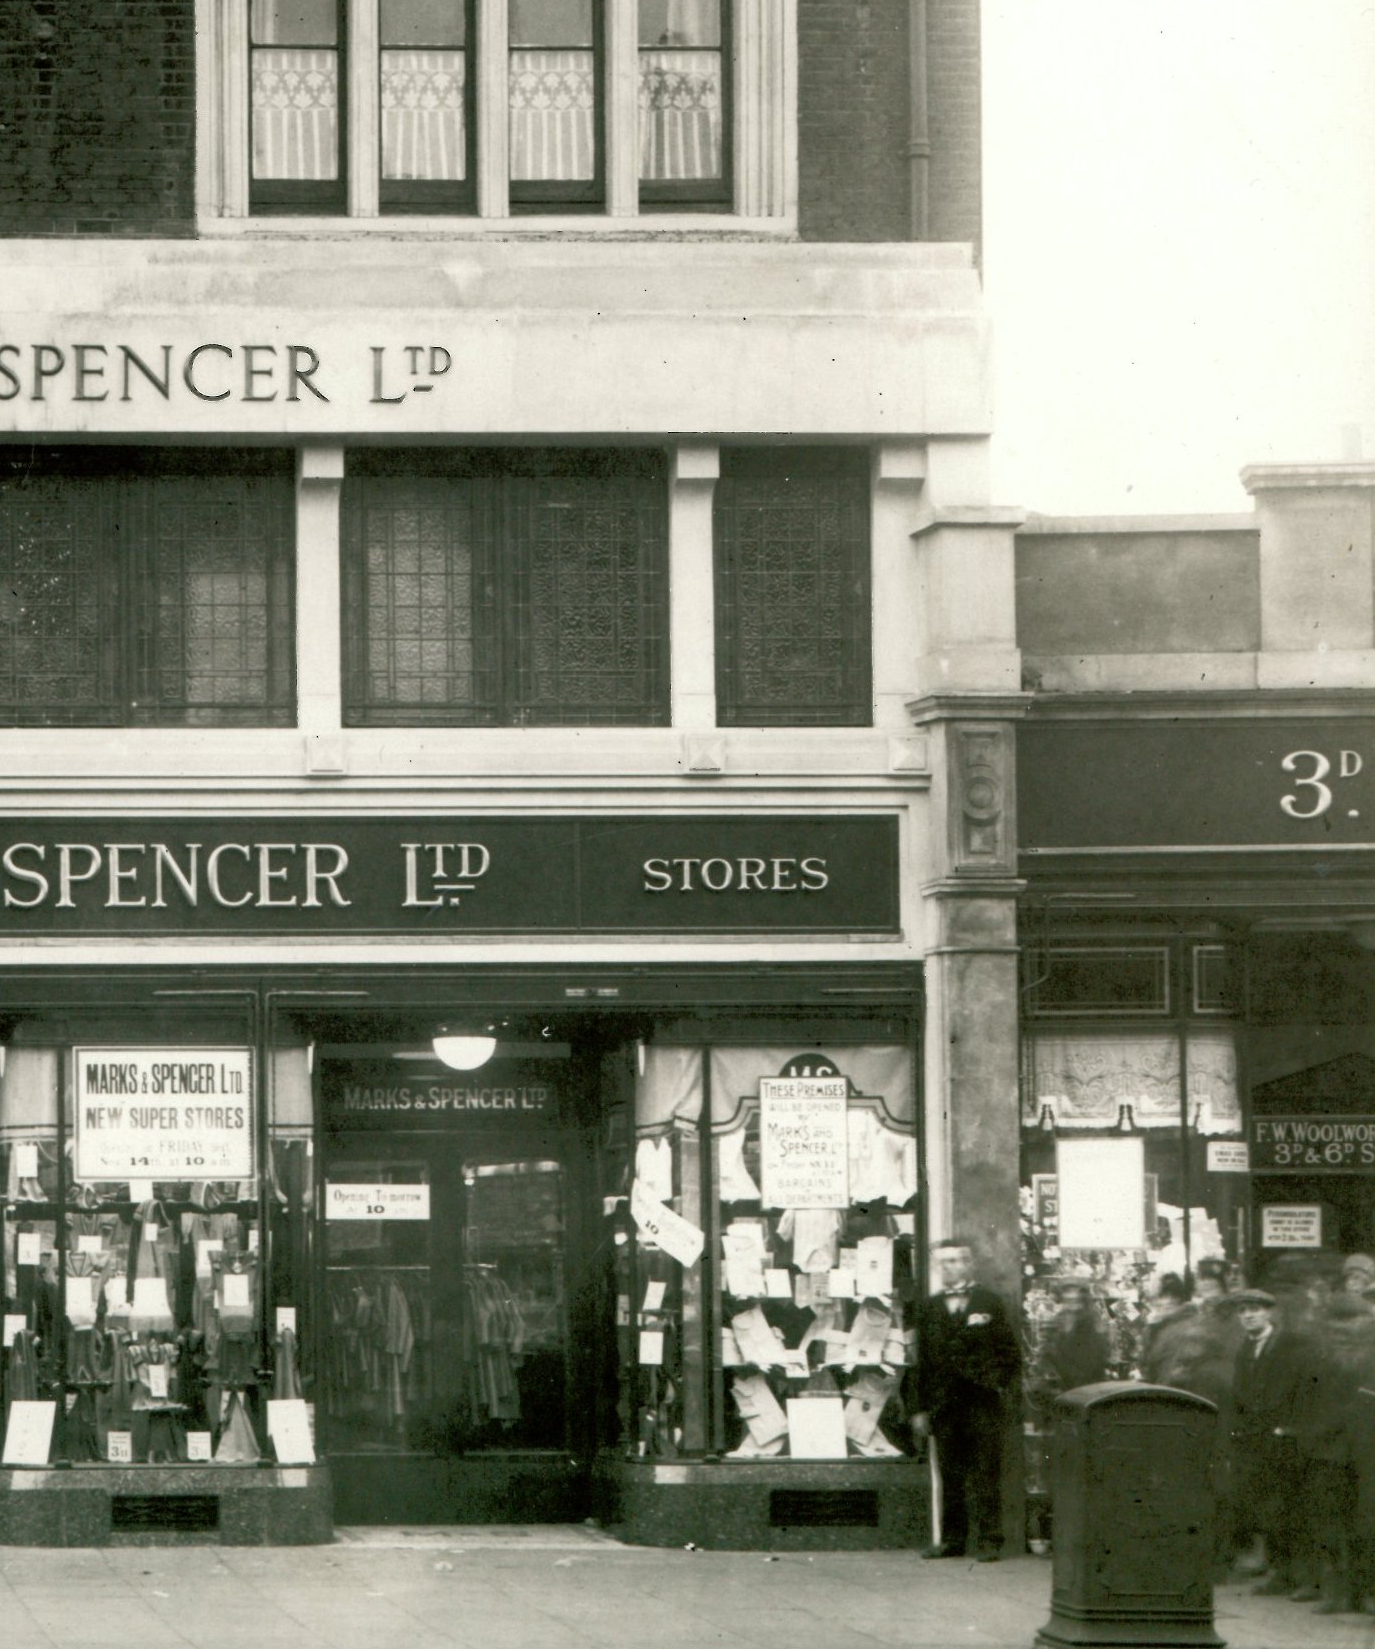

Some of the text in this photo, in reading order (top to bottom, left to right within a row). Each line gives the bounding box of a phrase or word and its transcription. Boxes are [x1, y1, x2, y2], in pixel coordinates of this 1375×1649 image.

[2, 842, 352, 909] SPENCER
[642, 856, 830, 892] STORES
[86, 1064, 137, 1094] MARKS
[141, 1071, 148, 1094] &
[151, 1063, 215, 1094] SPENCER
[344, 1087, 411, 1110] MARKS
[414, 1095, 426, 1109] &
[428, 1086, 516, 1110] SPENCER
[763, 1081, 845, 1098] THESE PREMISES
[806, 1102, 842, 1112] OPENED
[86, 1107, 244, 1129] NEW SUPER STORES
[767, 1122, 810, 1141] MARKS
[779, 1139, 828, 1158] SPENCER
[1305, 1147, 1321, 1164] &
[185, 1156, 205, 1166] 10
[777, 1178, 833, 1189] BARGAINS
[333, 1188, 369, 1204] Opening
[366, 1204, 385, 1214] 10
[645, 1219, 660, 1235] 10
